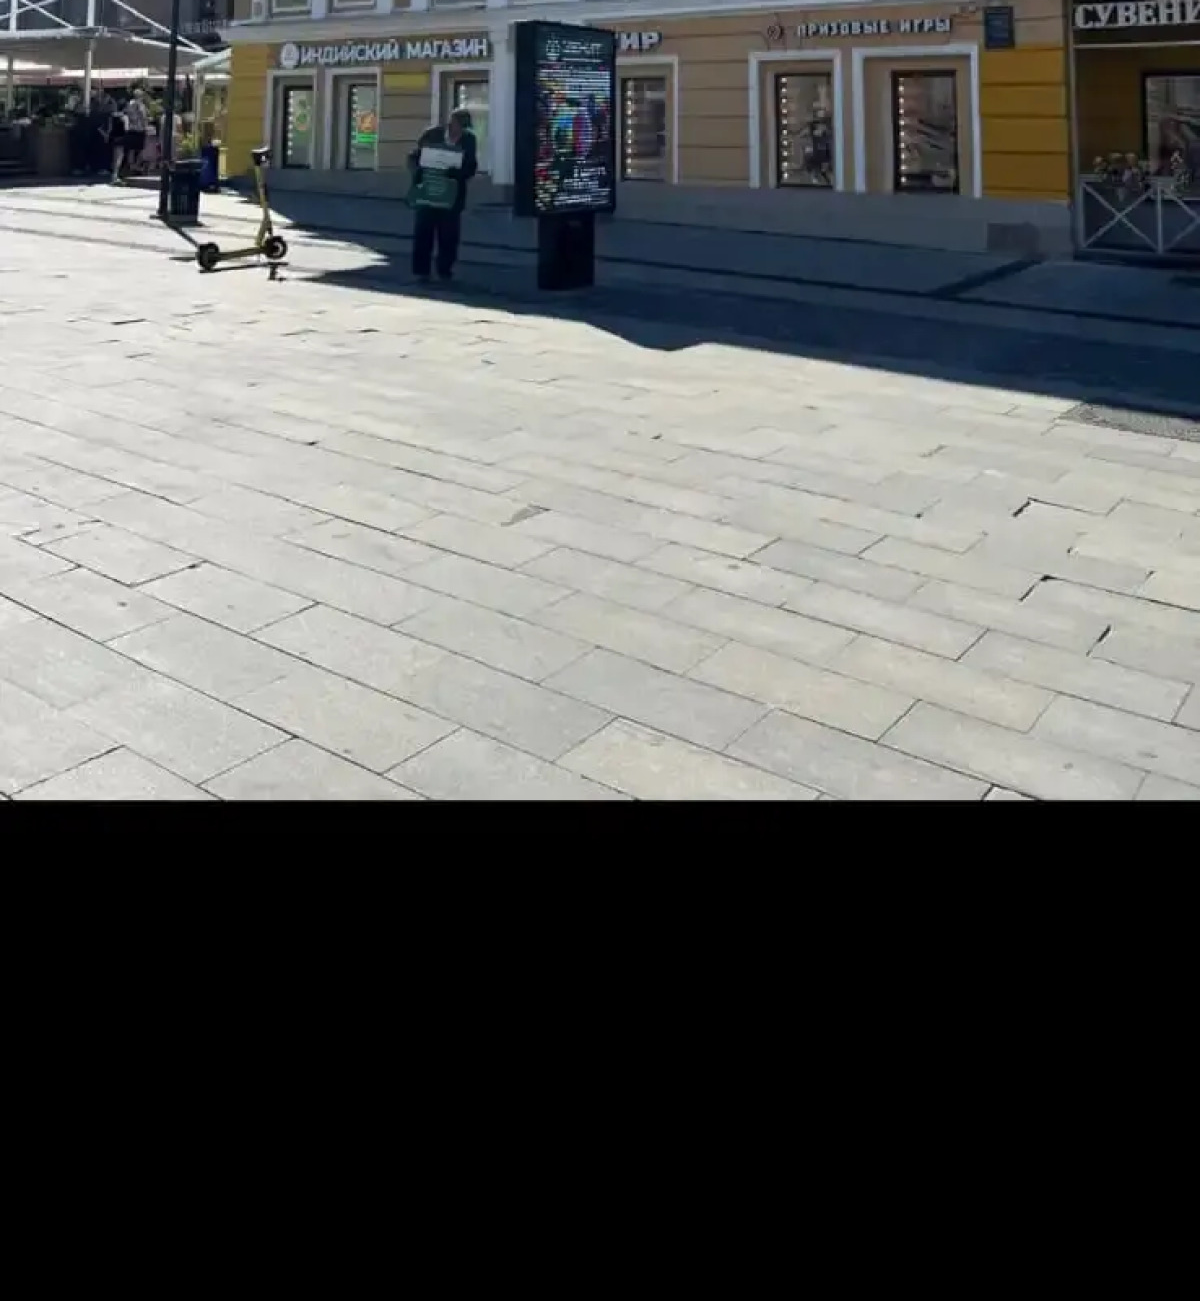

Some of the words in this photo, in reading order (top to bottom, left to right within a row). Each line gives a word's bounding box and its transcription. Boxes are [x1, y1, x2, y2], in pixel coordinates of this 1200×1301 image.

[797, 20, 890, 38] ПРИЗОВЫЕ
[899, 18, 951, 34] ИГРЫ
[301, 39, 399, 63] ИНДИЙСКИЙ
[407, 37, 487, 59] МАГАЗИН
